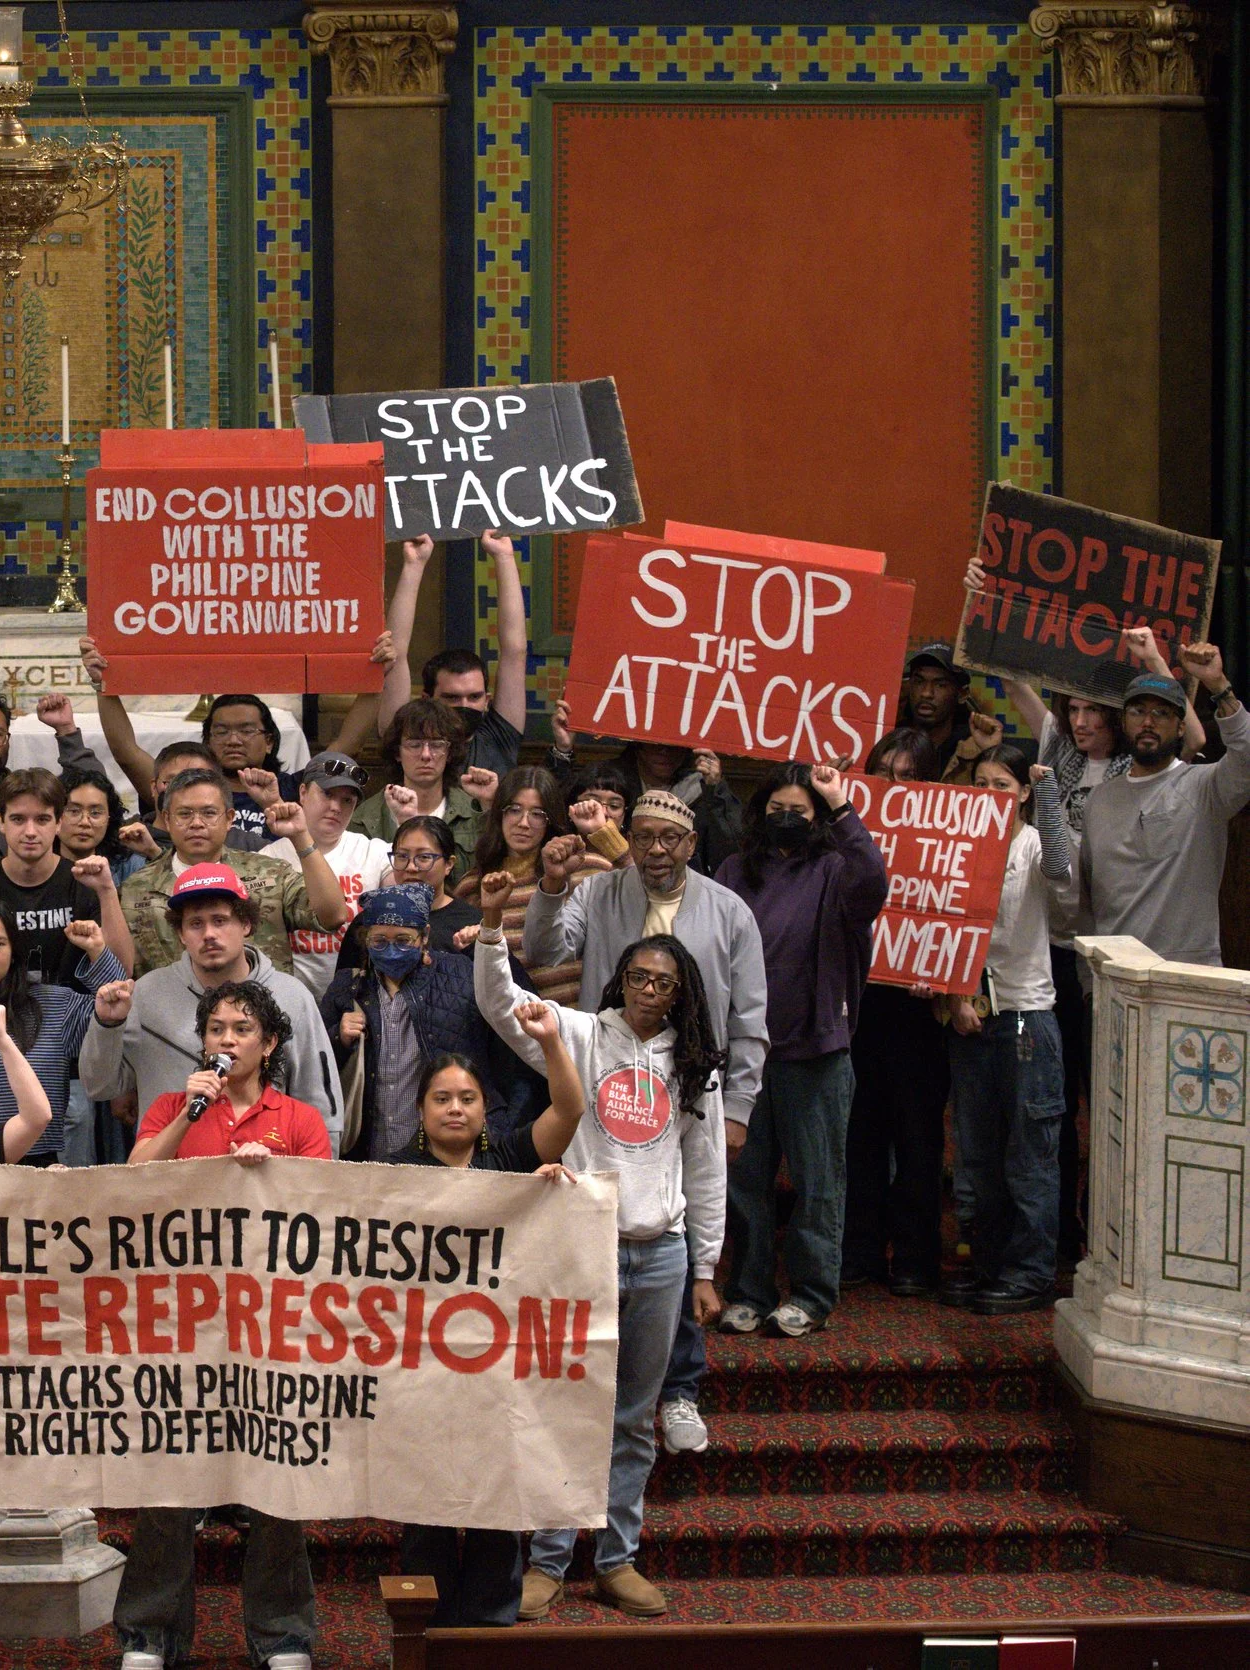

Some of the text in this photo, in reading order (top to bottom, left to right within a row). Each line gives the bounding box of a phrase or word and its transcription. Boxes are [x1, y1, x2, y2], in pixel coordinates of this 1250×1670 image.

[378, 395, 526, 439] STOP
[407, 435, 494, 464] THE
[96, 484, 376, 522] END COLLUSION
[384, 458, 617, 529] TTACKS
[162, 523, 308, 559] WITH THE
[151, 561, 321, 597] PHILIPPINE
[981, 513, 1203, 619] STOP THE
[114, 599, 359, 635] GOVERNMENT!
[630, 549, 851, 654] STOP
[690, 633, 756, 673] THE
[593, 654, 886, 764] ATTACKS!
[881, 786, 1012, 841] COLLUSION
[916, 837, 973, 878] THE
[179, 876, 225, 890] washington
[16, 907, 73, 931] ESTINE
[610, 1081, 629, 1093] THE
[605, 1108, 659, 1128] FOR PEACE
[109, 1208, 250, 1271] RIGHT
[262, 1209, 320, 1275] TO
[332, 1215, 505, 1290] RESIST!
[84, 1272, 591, 1381] REPRESSION!
[134, 1364, 182, 1409] ON
[197, 1364, 378, 1420] PHILIPPINE
[5, 1411, 131, 1456] RIGHTS
[141, 1409, 332, 1467] DEFENDERS!
